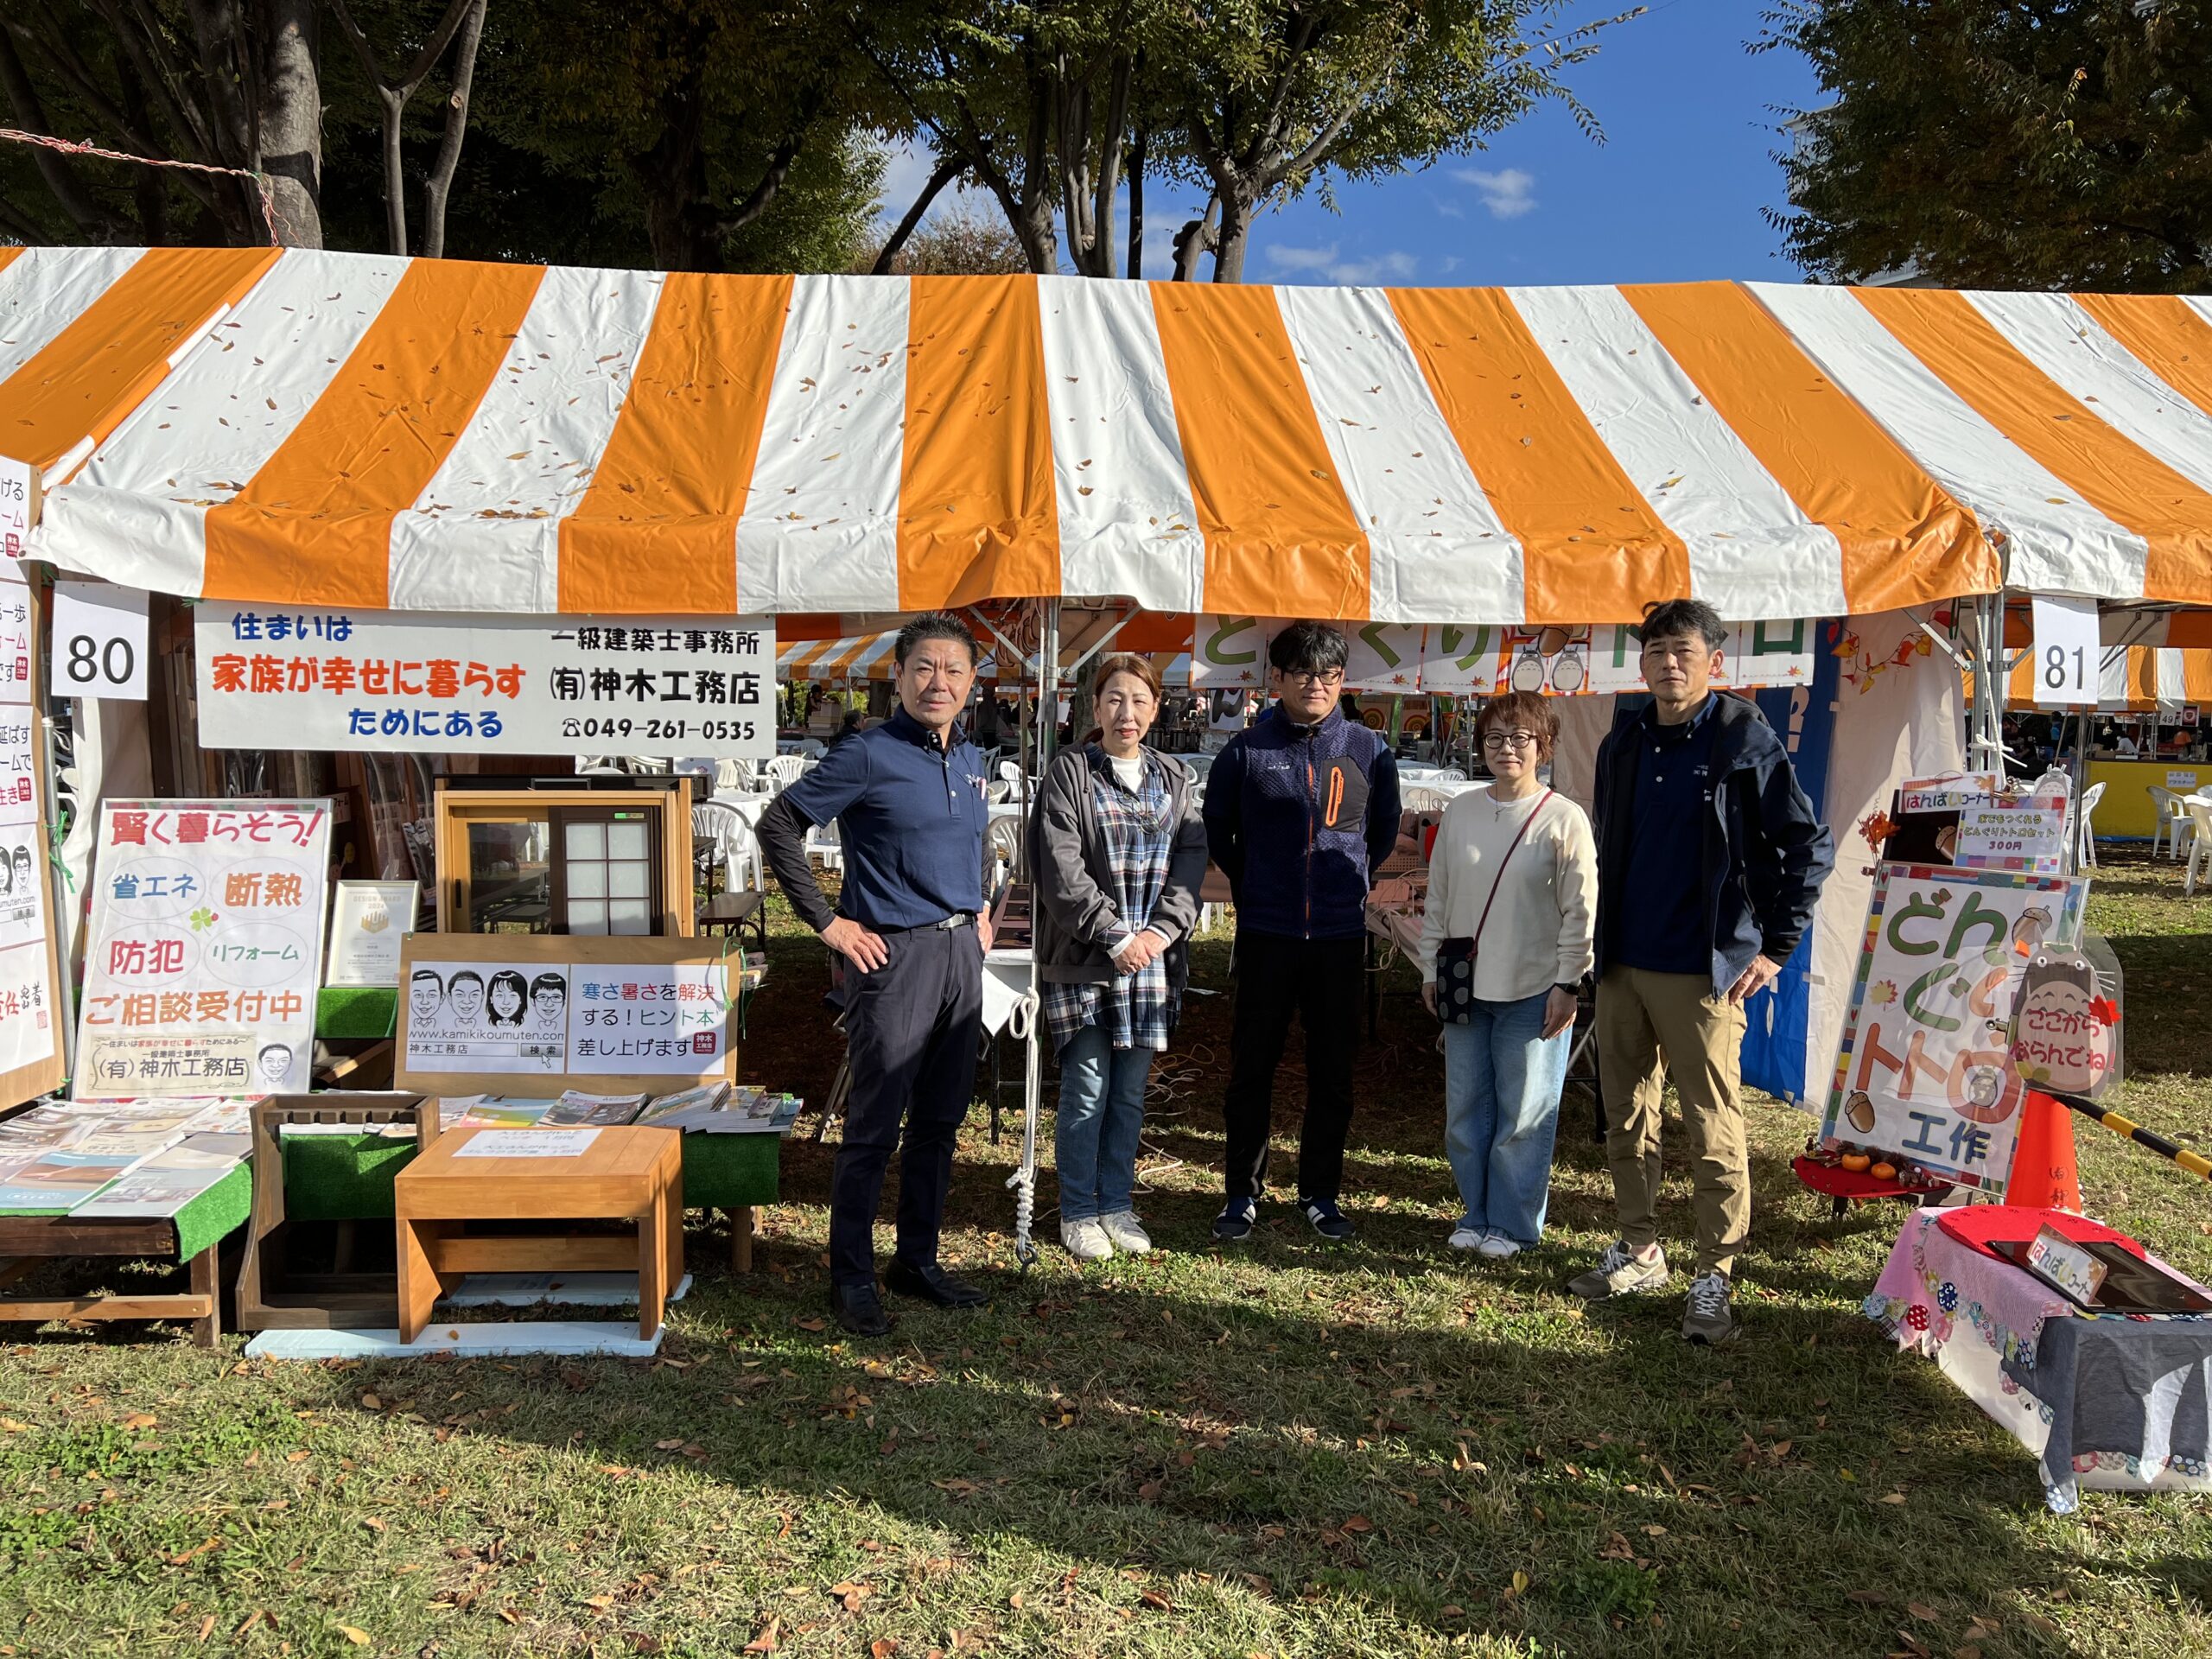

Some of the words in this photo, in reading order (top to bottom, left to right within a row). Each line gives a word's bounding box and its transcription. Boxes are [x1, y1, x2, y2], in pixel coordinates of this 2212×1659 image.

[0, 603, 26, 622] 一歩
[232, 612, 353, 641] 住まいは
[0, 632, 27, 650] ーム
[551, 626, 760, 655] 一級建築士事務所
[67, 635, 134, 684] 80
[2045, 645, 2083, 690] 81
[212, 653, 526, 699] 家族が幸せに暮らす
[348, 708, 502, 737] ためにある
[583, 718, 755, 741] 049-261-0535
[1906, 791, 1990, 809] はんばいコーナー
[111, 808, 325, 847] 賢く暮らそう!
[1963, 827, 2055, 838] どんぐりトトロセット
[1978, 814, 2042, 824] 家でもつくれる
[1989, 841, 2022, 850] 300円
[111, 874, 197, 899] 省エネ
[224, 872, 302, 907] 断熱
[1887, 887, 2008, 966] どん
[108, 939, 185, 975] 防犯
[212, 944, 300, 963] リフォーム
[582, 982, 715, 1001] 寒さ暑さを解決
[86, 989, 302, 1027] ご相談受付中
[582, 1008, 715, 1027] する！ヒント本
[2028, 1009, 2100, 1038] ここから
[410, 1044, 468, 1054] 神木工務店
[577, 1039, 691, 1056] 差し上げます
[1856, 1022, 2022, 1124] トトロ
[1902, 1110, 1991, 1164] 工作
